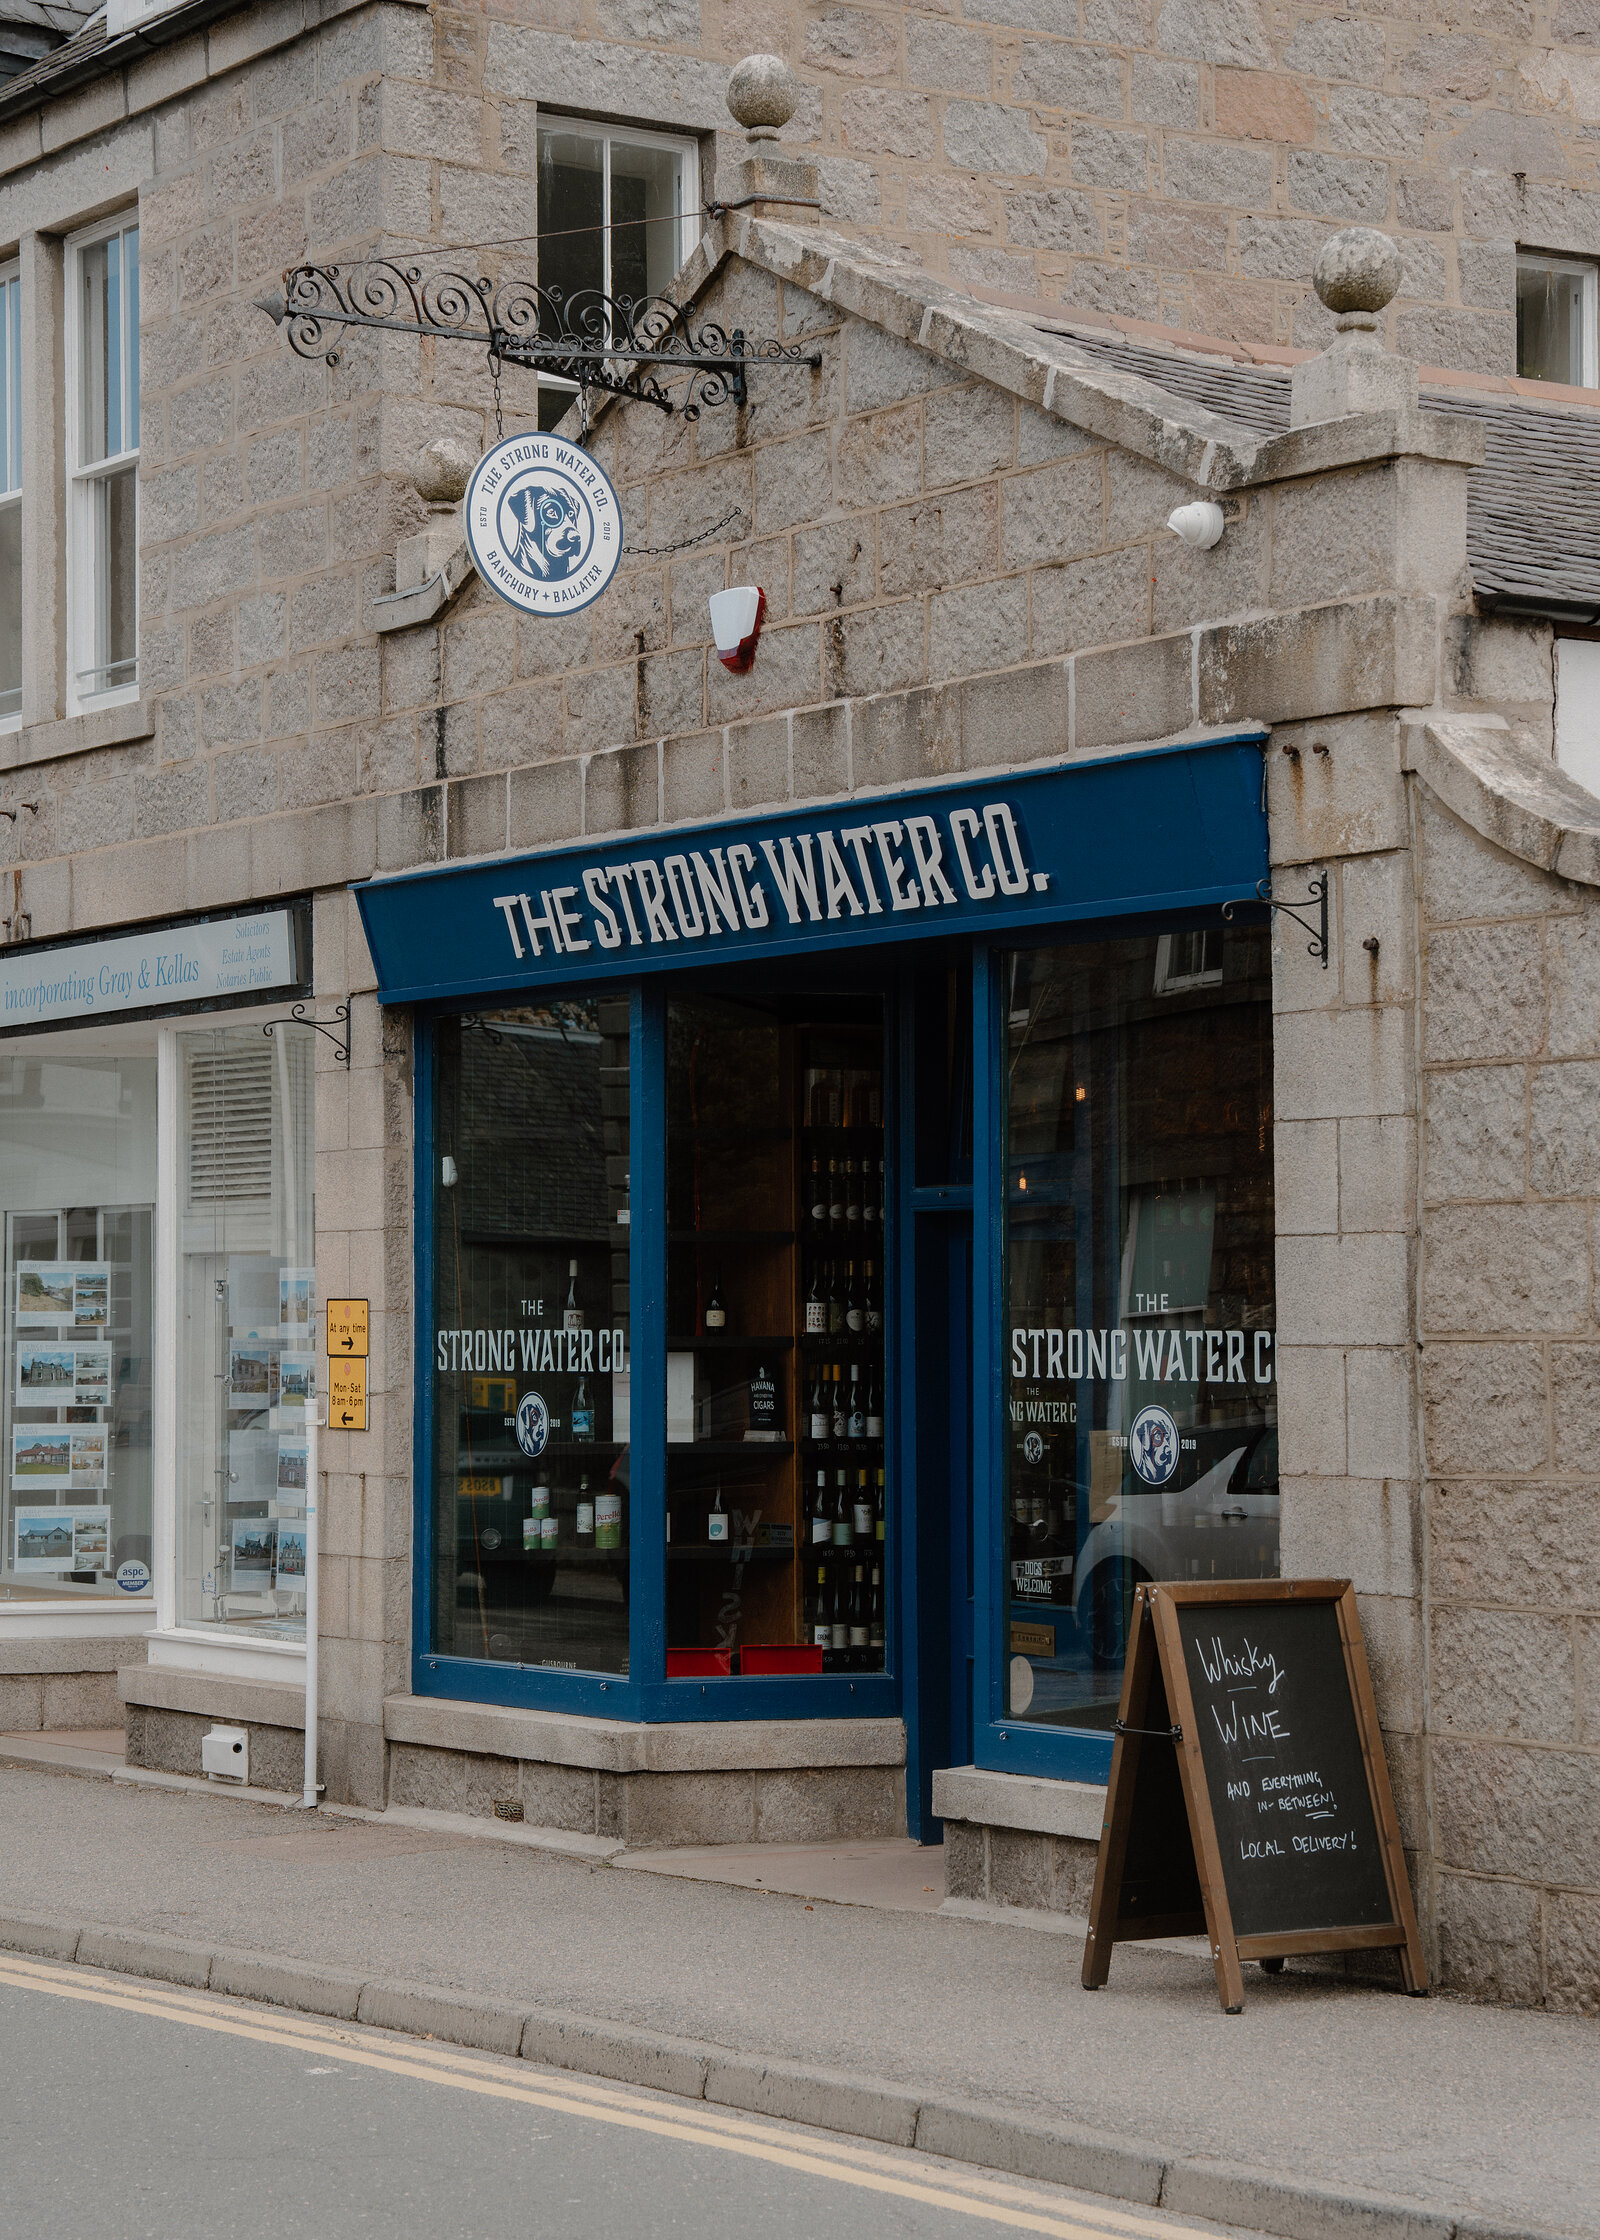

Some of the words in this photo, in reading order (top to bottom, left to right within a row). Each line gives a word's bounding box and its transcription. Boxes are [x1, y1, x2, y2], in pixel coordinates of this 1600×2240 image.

[482, 467, 502, 496] THE
[500, 444, 549, 470] STRONG
[556, 448, 596, 487] WATER
[592, 488, 608, 512] CO.
[486, 550, 539, 600] BANCHORY
[554, 564, 602, 602] BALLATER
[493, 886, 593, 959] THE
[583, 841, 771, 949] STRONG
[760, 815, 958, 924] WATER
[949, 802, 1051, 900] CO.
[235, 920, 270, 940] Solicitors
[222, 948, 244, 966] Estate
[246, 944, 272, 963] Agents
[4, 970, 95, 1012] incorporating
[100, 965, 132, 999] Gray
[138, 958, 150, 990] &
[155, 953, 200, 988] Kellas
[216, 969, 247, 989] Notaries
[249, 966, 272, 984] Public
[521, 1300, 544, 1316] THE
[1136, 1293, 1169, 1312] THE
[330, 1322, 337, 1332] At
[340, 1324, 350, 1334] any
[352, 1322, 366, 1332] time
[438, 1330, 515, 1372] STRONG
[518, 1329, 594, 1372] WATER
[598, 1329, 630, 1373] CO.
[1012, 1328, 1127, 1380] STRONG
[1132, 1329, 1247, 1383] WATER
[1254, 1330, 1277, 1384] C
[750, 1381, 775, 1392] HAVANA
[1026, 1388, 1040, 1396] THE
[753, 1400, 774, 1410] CIGARS
[1026, 1402, 1068, 1422] WATER
[1112, 1436, 1128, 1447] ESTD
[1181, 1439, 1196, 1450] 2019
[122, 1568, 143, 1578] aspc
[1025, 1561, 1042, 1576] DOGS
[1016, 1578, 1052, 1594] WELCOME
[1196, 1636, 1284, 1694] Whisky
[1211, 1700, 1290, 1744] WINE
[1227, 1780, 1250, 1800] AND
[1262, 1771, 1323, 1792] EVERYTHING
[1240, 1840, 1286, 1860] LOCAL
[1292, 1831, 1357, 1854] DELIVERY!
